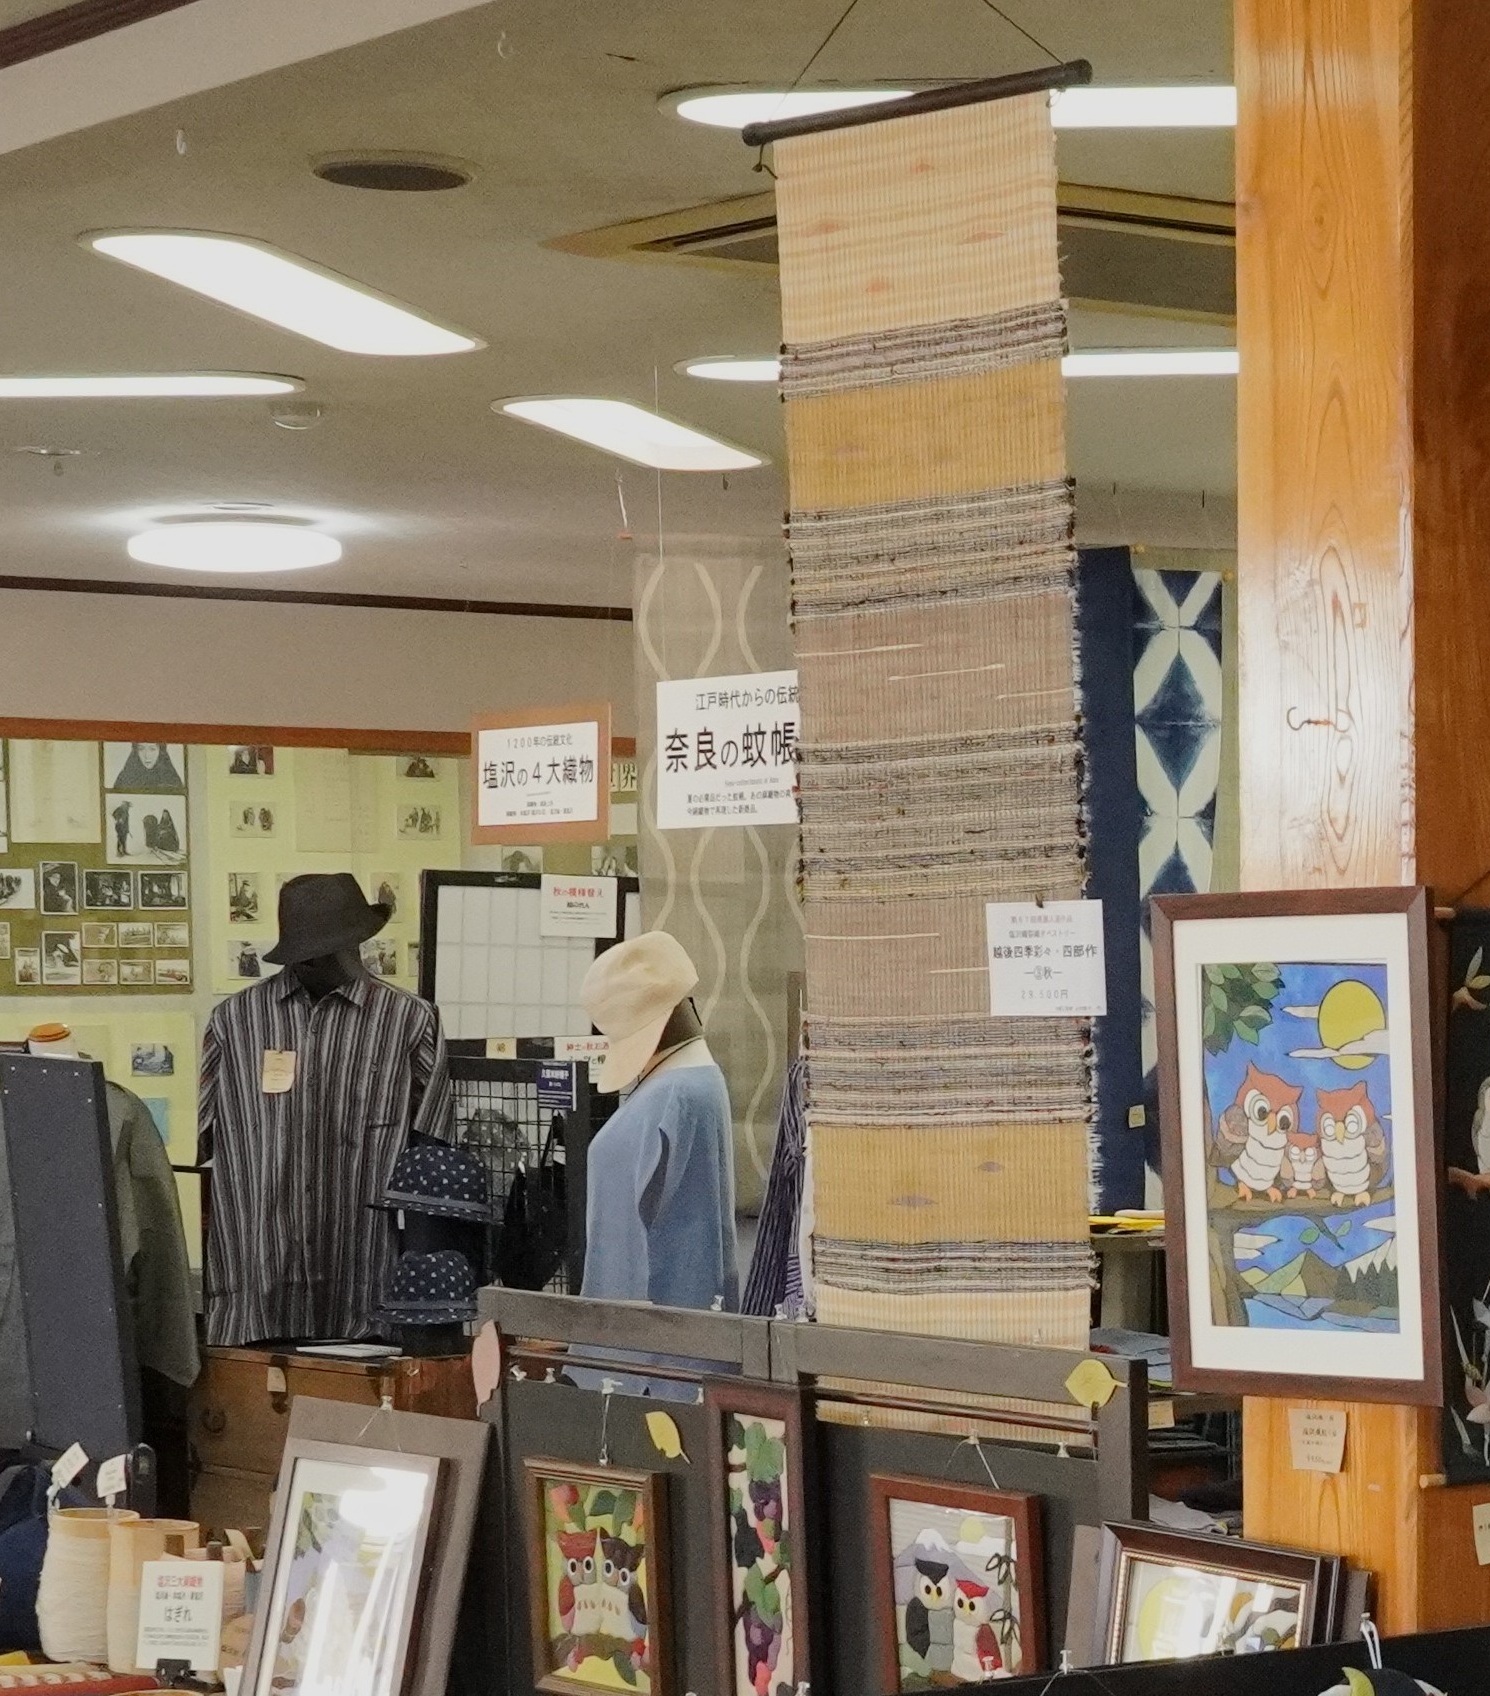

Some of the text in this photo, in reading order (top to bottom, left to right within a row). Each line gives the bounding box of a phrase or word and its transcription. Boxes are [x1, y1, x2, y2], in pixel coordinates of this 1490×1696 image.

[665, 721, 798, 773] 奈良の蚊帳
[483, 754, 594, 790] 塩沢の4大織物
